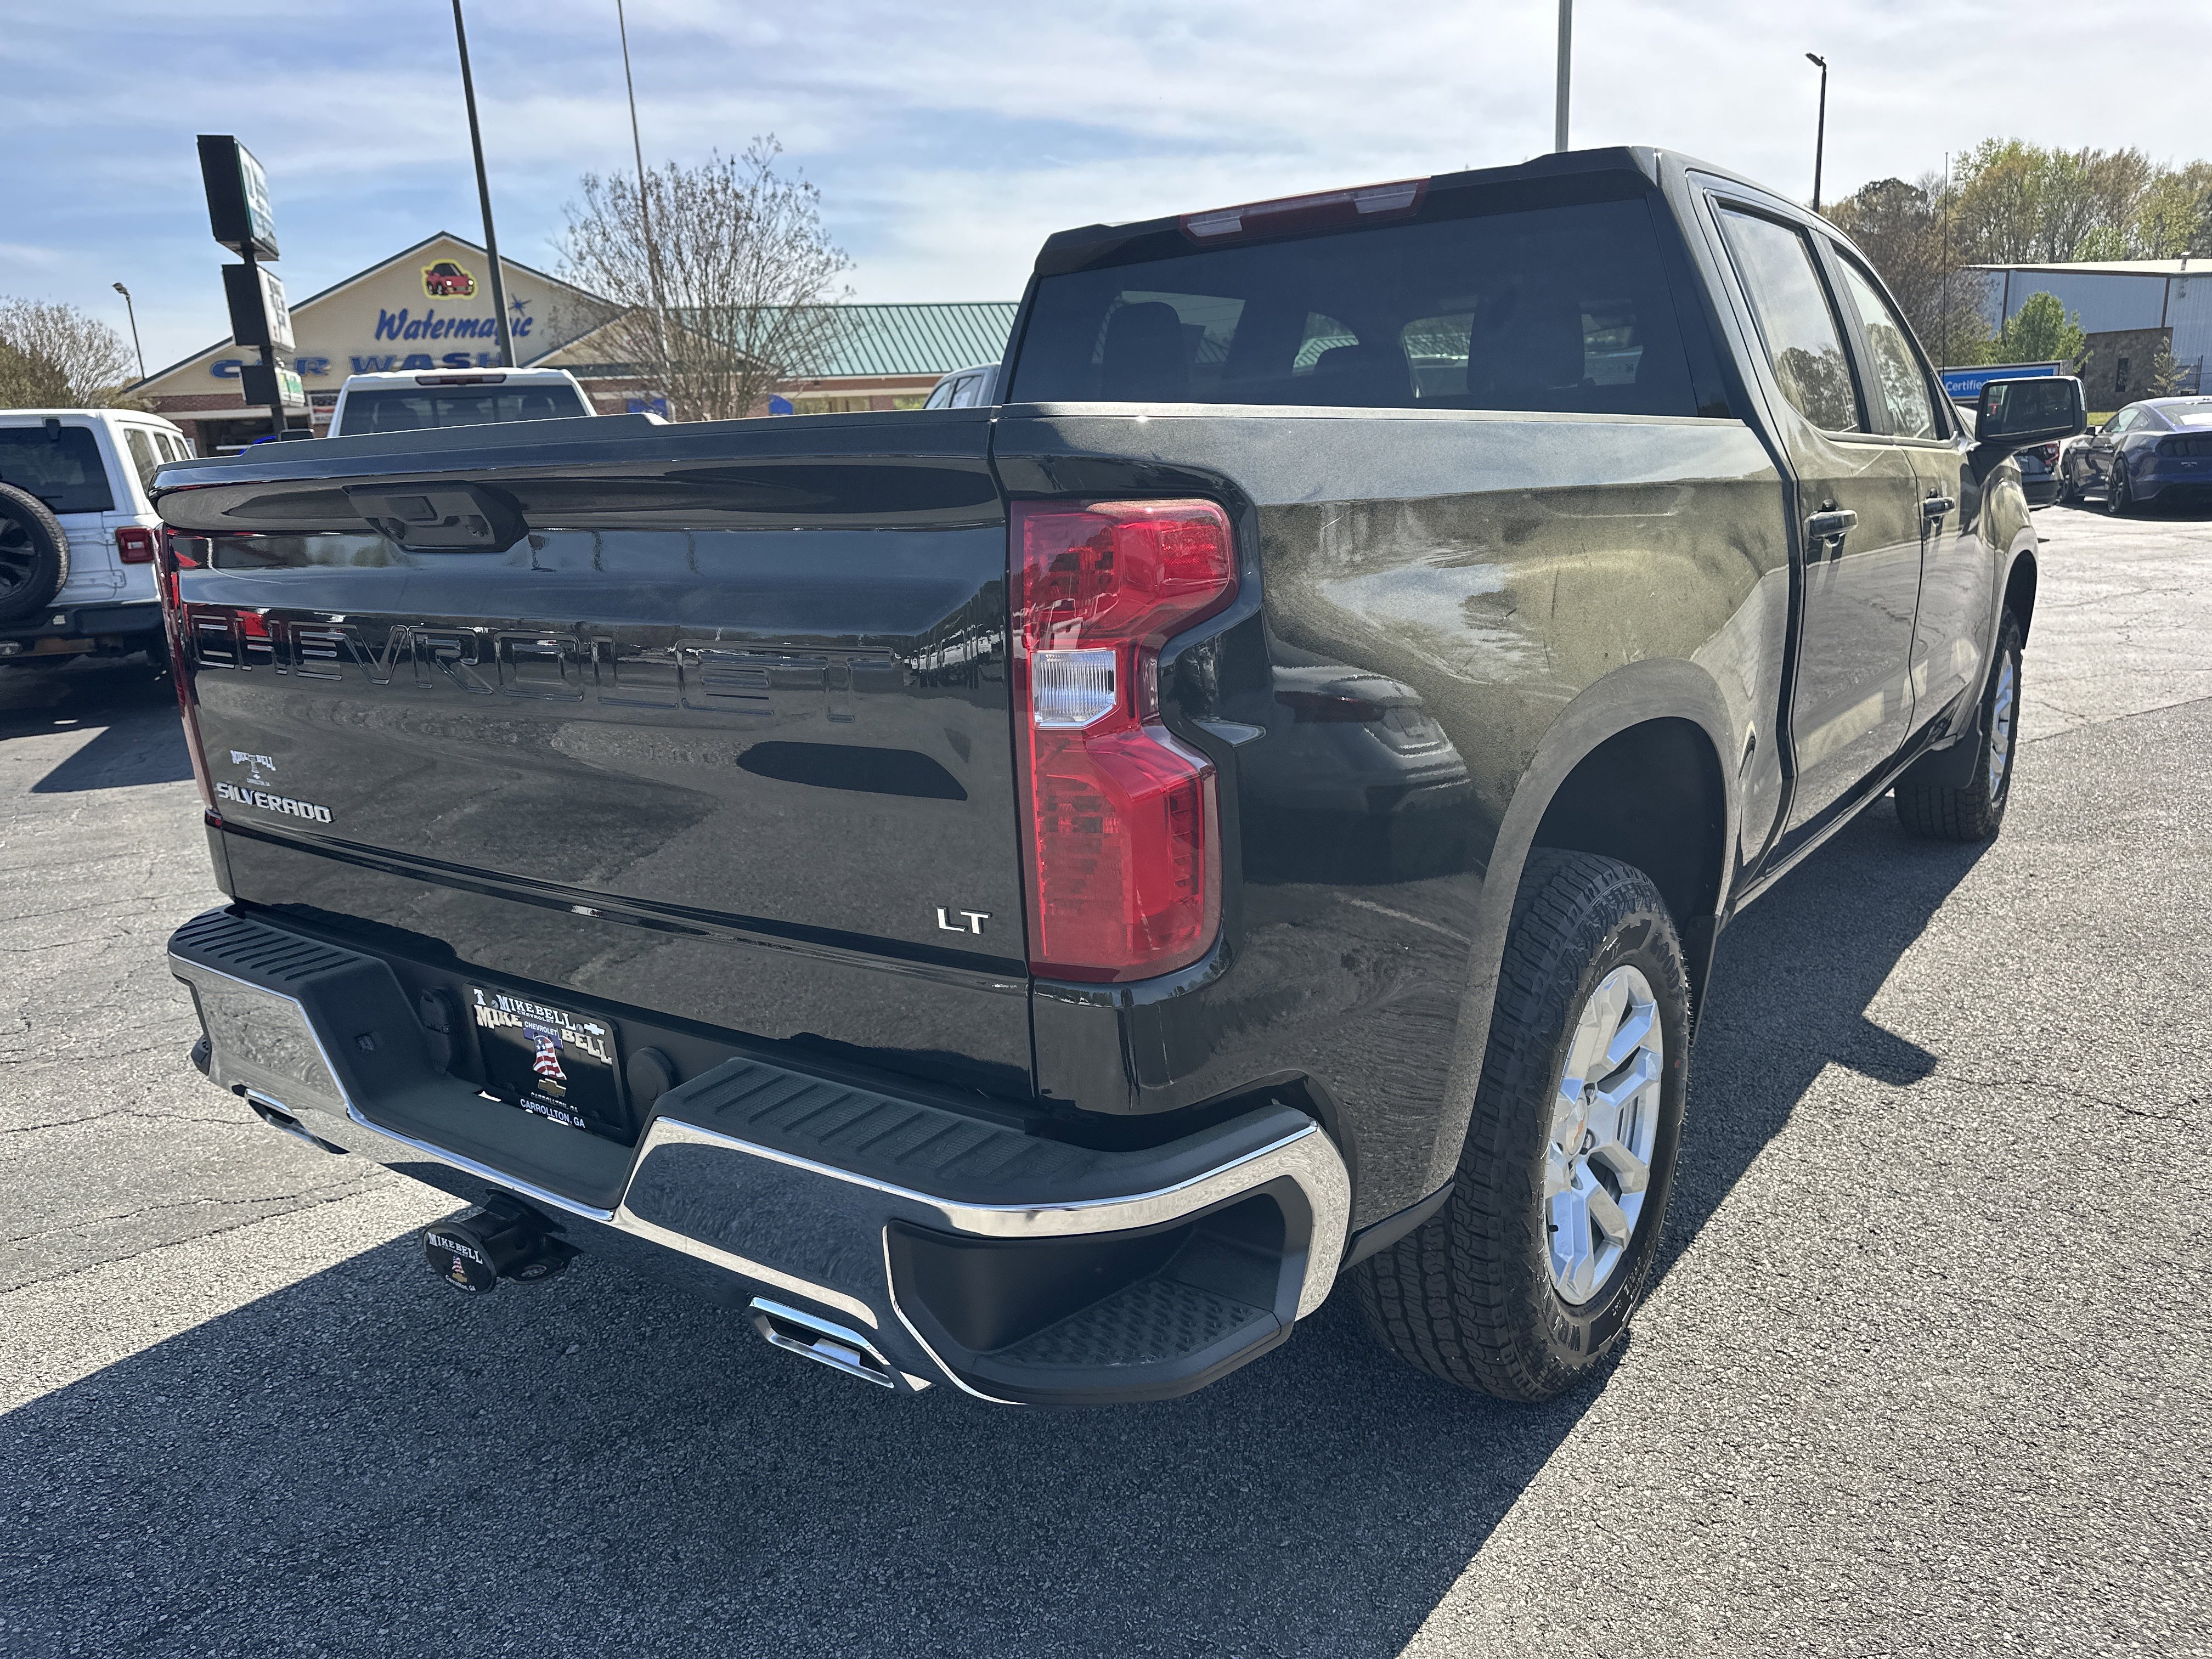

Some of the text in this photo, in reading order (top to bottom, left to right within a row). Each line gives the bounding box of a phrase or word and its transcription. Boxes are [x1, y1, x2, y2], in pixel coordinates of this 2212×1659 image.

[211, 357, 330, 379] CR
[190, 613, 897, 723] CHEVROLET
[217, 781, 334, 823] SILVERADO
[936, 905, 992, 934] LT
[496, 994, 577, 1030] MIKE BELL
[517, 1010, 554, 1024] CHEVROLET
[473, 1005, 613, 1066] MIKE BELL
[524, 1020, 558, 1036] CHEVROLET
[520, 1098, 586, 1128] CARROLLTON, GA
[428, 1232, 483, 1265] MIKE BELL
